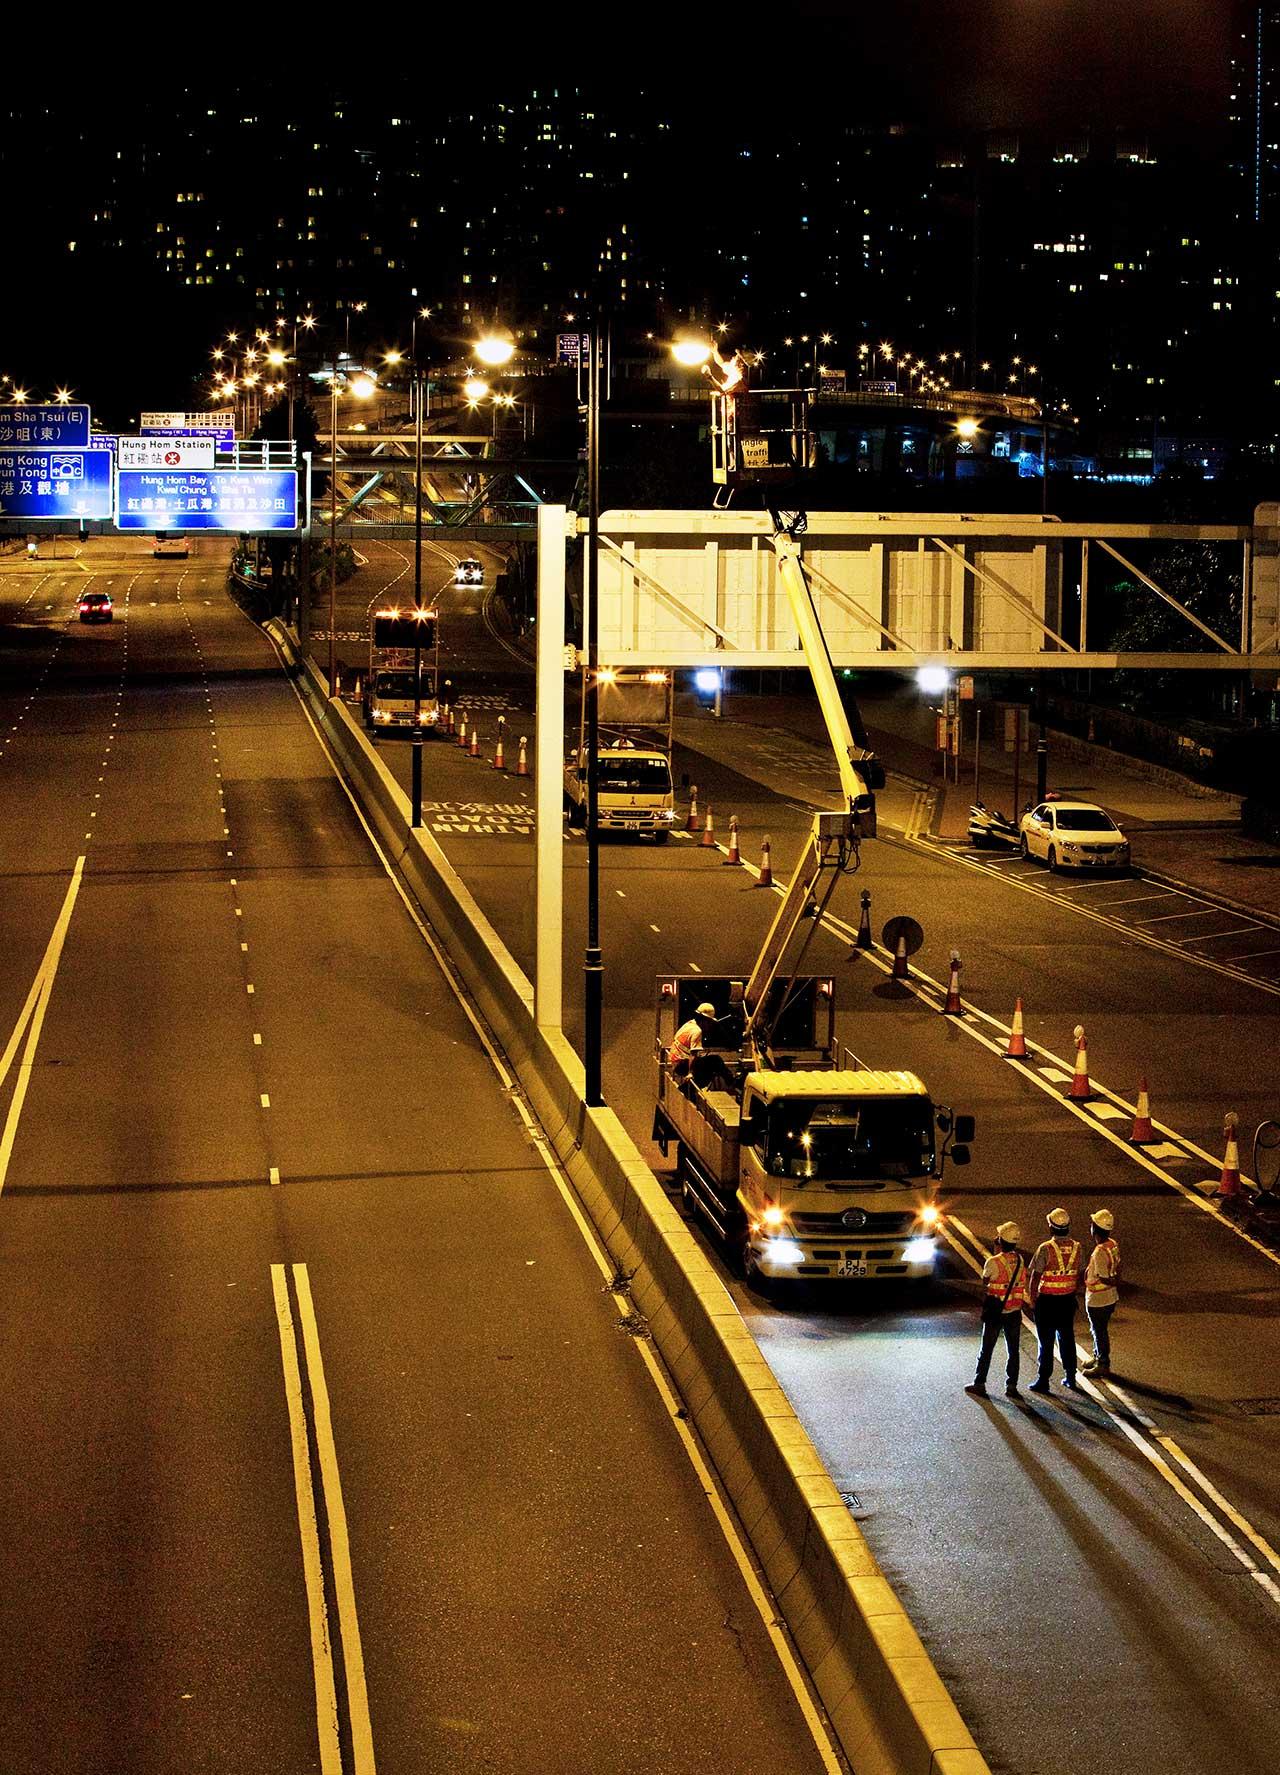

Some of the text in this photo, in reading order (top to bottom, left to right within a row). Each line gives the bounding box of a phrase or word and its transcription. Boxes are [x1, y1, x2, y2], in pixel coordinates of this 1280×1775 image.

[0, 412, 83, 424] m Sha Tsui (E)
[0, 427, 61, 441] 沙咀(東)
[122, 440, 212, 450] Hung Hom Station
[742, 439, 763, 447] ingle
[0, 456, 48, 468] ng Kong
[18, 467, 48, 479] Tong
[141, 475, 163, 485] Hung
[166, 475, 187, 484] Hom
[215, 475, 226, 484] To
[230, 475, 249, 484] Kwa
[253, 475, 273, 484] Wan
[0, 480, 70, 495] 港及觀塘
[157, 485, 178, 493] Kwai
[179, 485, 207, 495] Chung
[210, 485, 217, 494] &
[242, 485, 255, 494] Tin
[436, 814, 535, 825] ROAD
[431, 823, 535, 834] ATHAN
[838, 1268, 866, 1276] 4729
